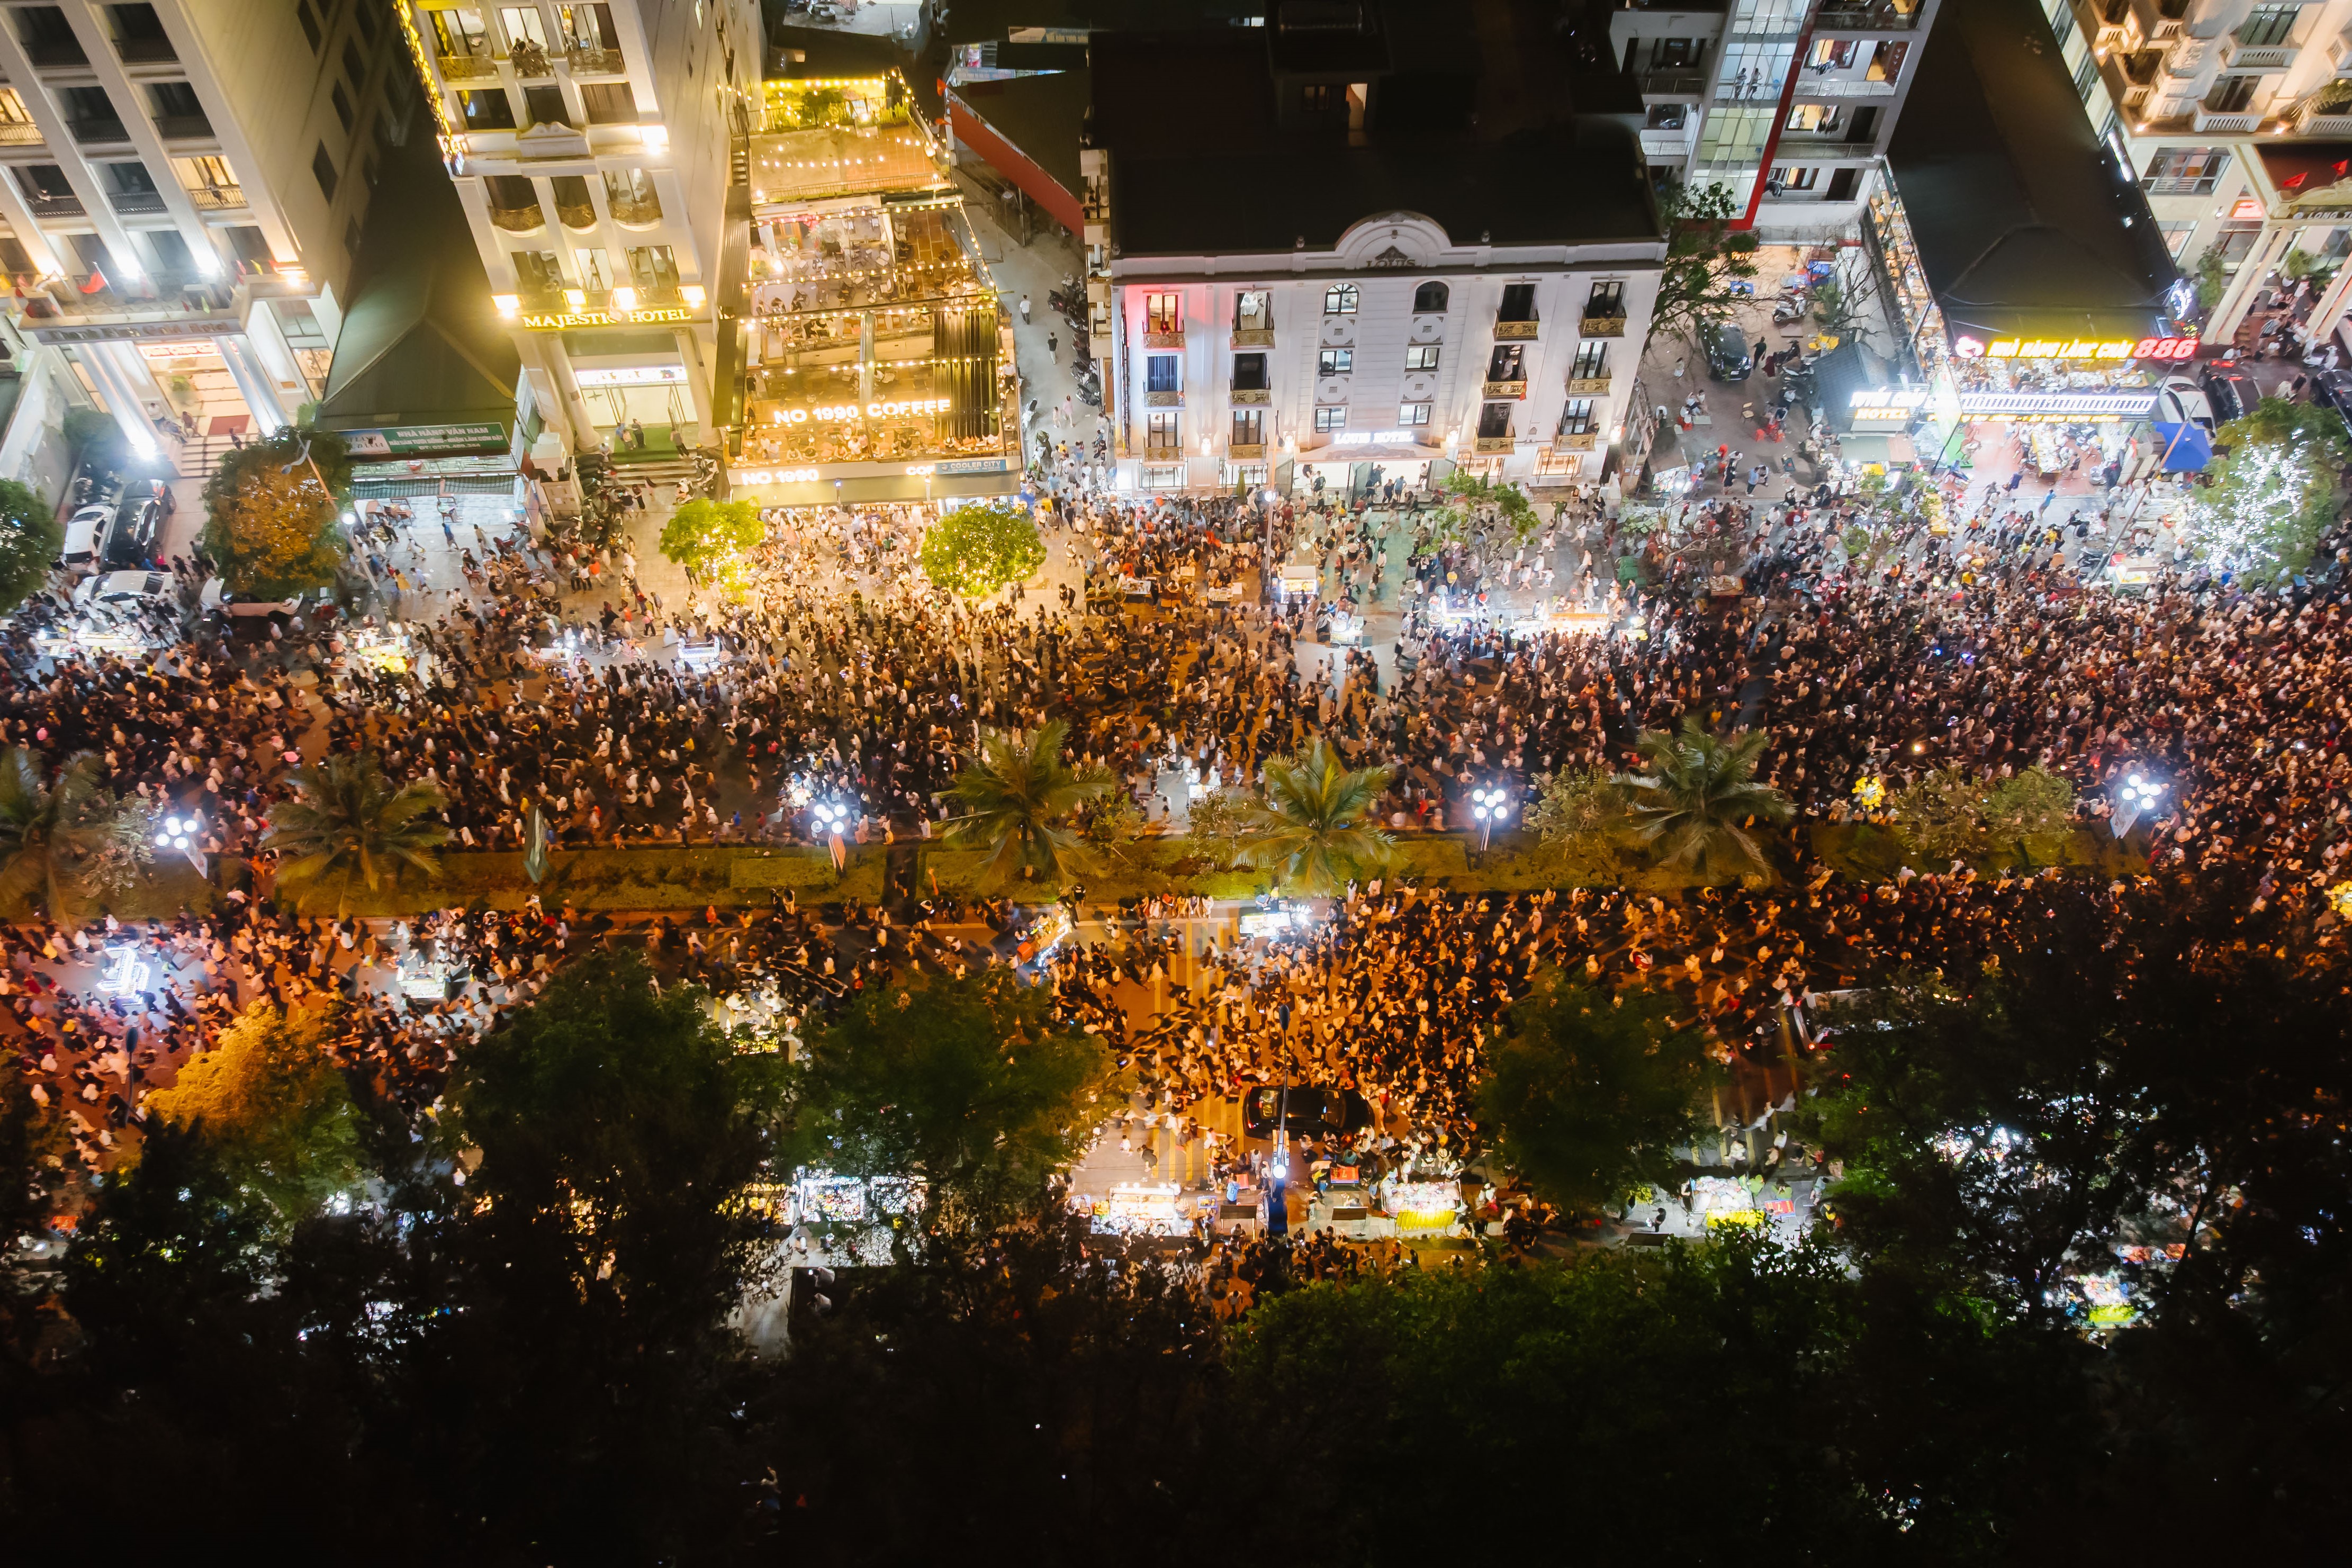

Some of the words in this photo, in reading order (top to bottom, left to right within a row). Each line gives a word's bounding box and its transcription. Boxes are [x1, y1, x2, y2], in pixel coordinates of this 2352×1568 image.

[628, 309, 691, 322] HOTEL
[2132, 337, 2198, 359] 886
[774, 409, 807, 424] NO
[813, 405, 859, 421] 1990
[1854, 408, 1909, 420] HOTEL
[1334, 432, 1371, 444] LOUIS
[1373, 431, 1414, 443] HOTEL
[741, 472, 772, 485] NO
[775, 469, 819, 483] 1990
